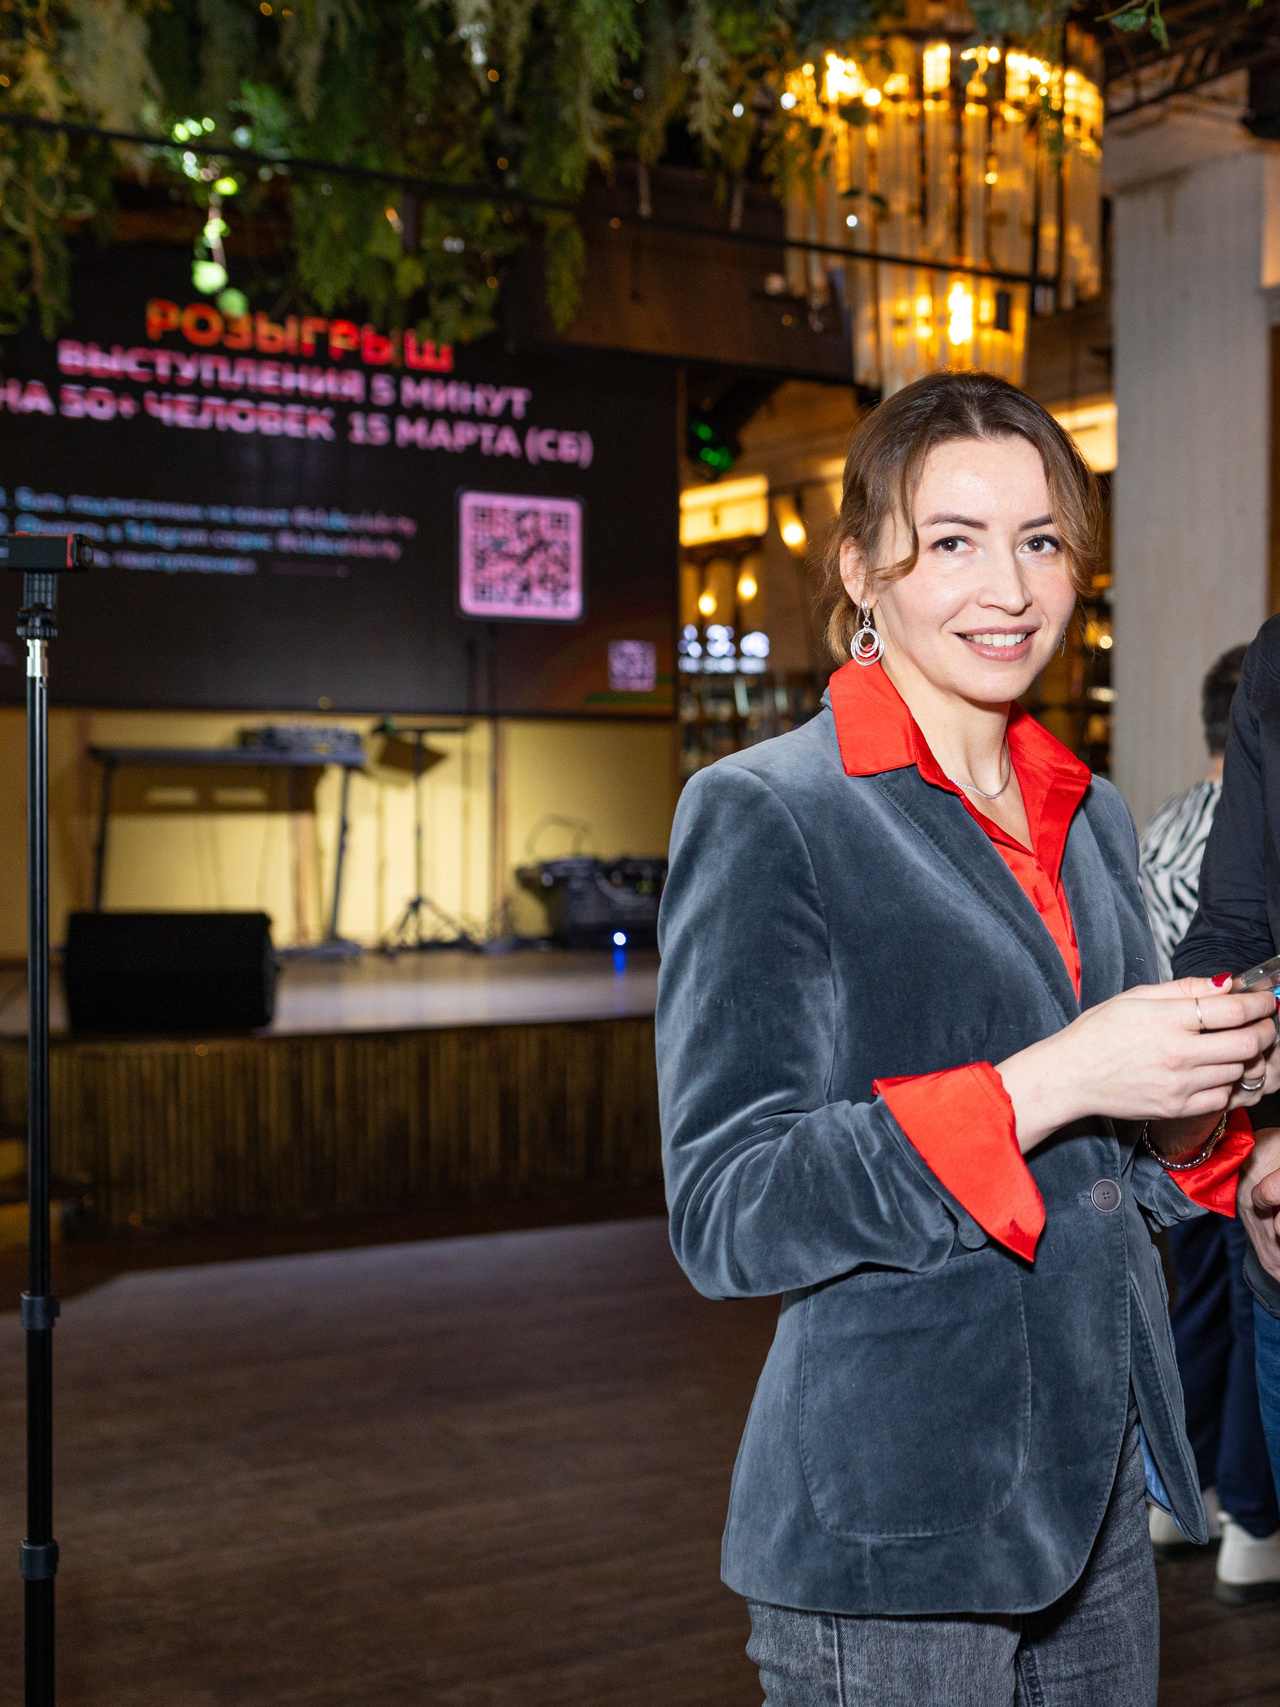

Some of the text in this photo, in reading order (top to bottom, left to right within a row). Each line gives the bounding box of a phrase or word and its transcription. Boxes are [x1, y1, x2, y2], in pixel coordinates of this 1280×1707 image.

[145, 298, 454, 374] РОЗЫГРЫШ
[57, 339, 532, 421] ВЫСТУПЛЕНИЯ 5 МИНУТ
[59, 383, 139, 421] 50+
[143, 390, 336, 442] ЧЕЛОВЕК
[348, 411, 391, 446] 15
[395, 414, 522, 459] МАРТА
[525, 425, 594, 469] (СБ)
